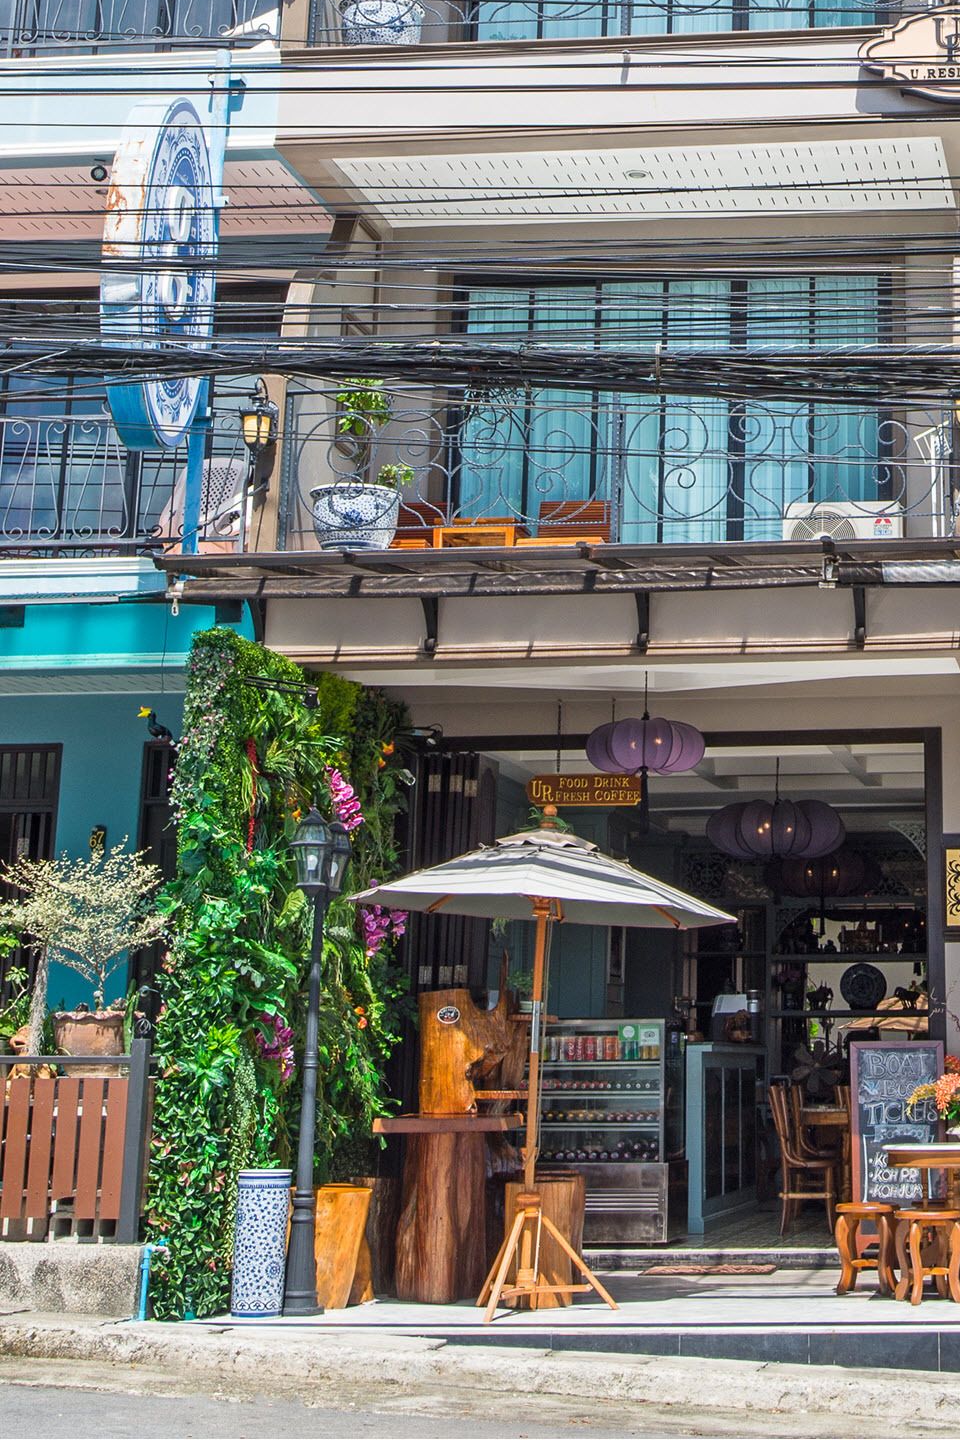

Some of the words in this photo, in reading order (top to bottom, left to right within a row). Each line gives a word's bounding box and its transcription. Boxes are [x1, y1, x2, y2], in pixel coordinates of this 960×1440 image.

[531, 780, 554, 802] UR
[560, 777, 588, 789] FOOD
[594, 777, 630, 788] DRINK
[555, 791, 590, 801] FRESH
[594, 790, 640, 801] COFFEE
[90, 831, 104, 848] 67
[867, 1052, 928, 1078] BOAT
[864, 1100, 938, 1126] TICKETS
